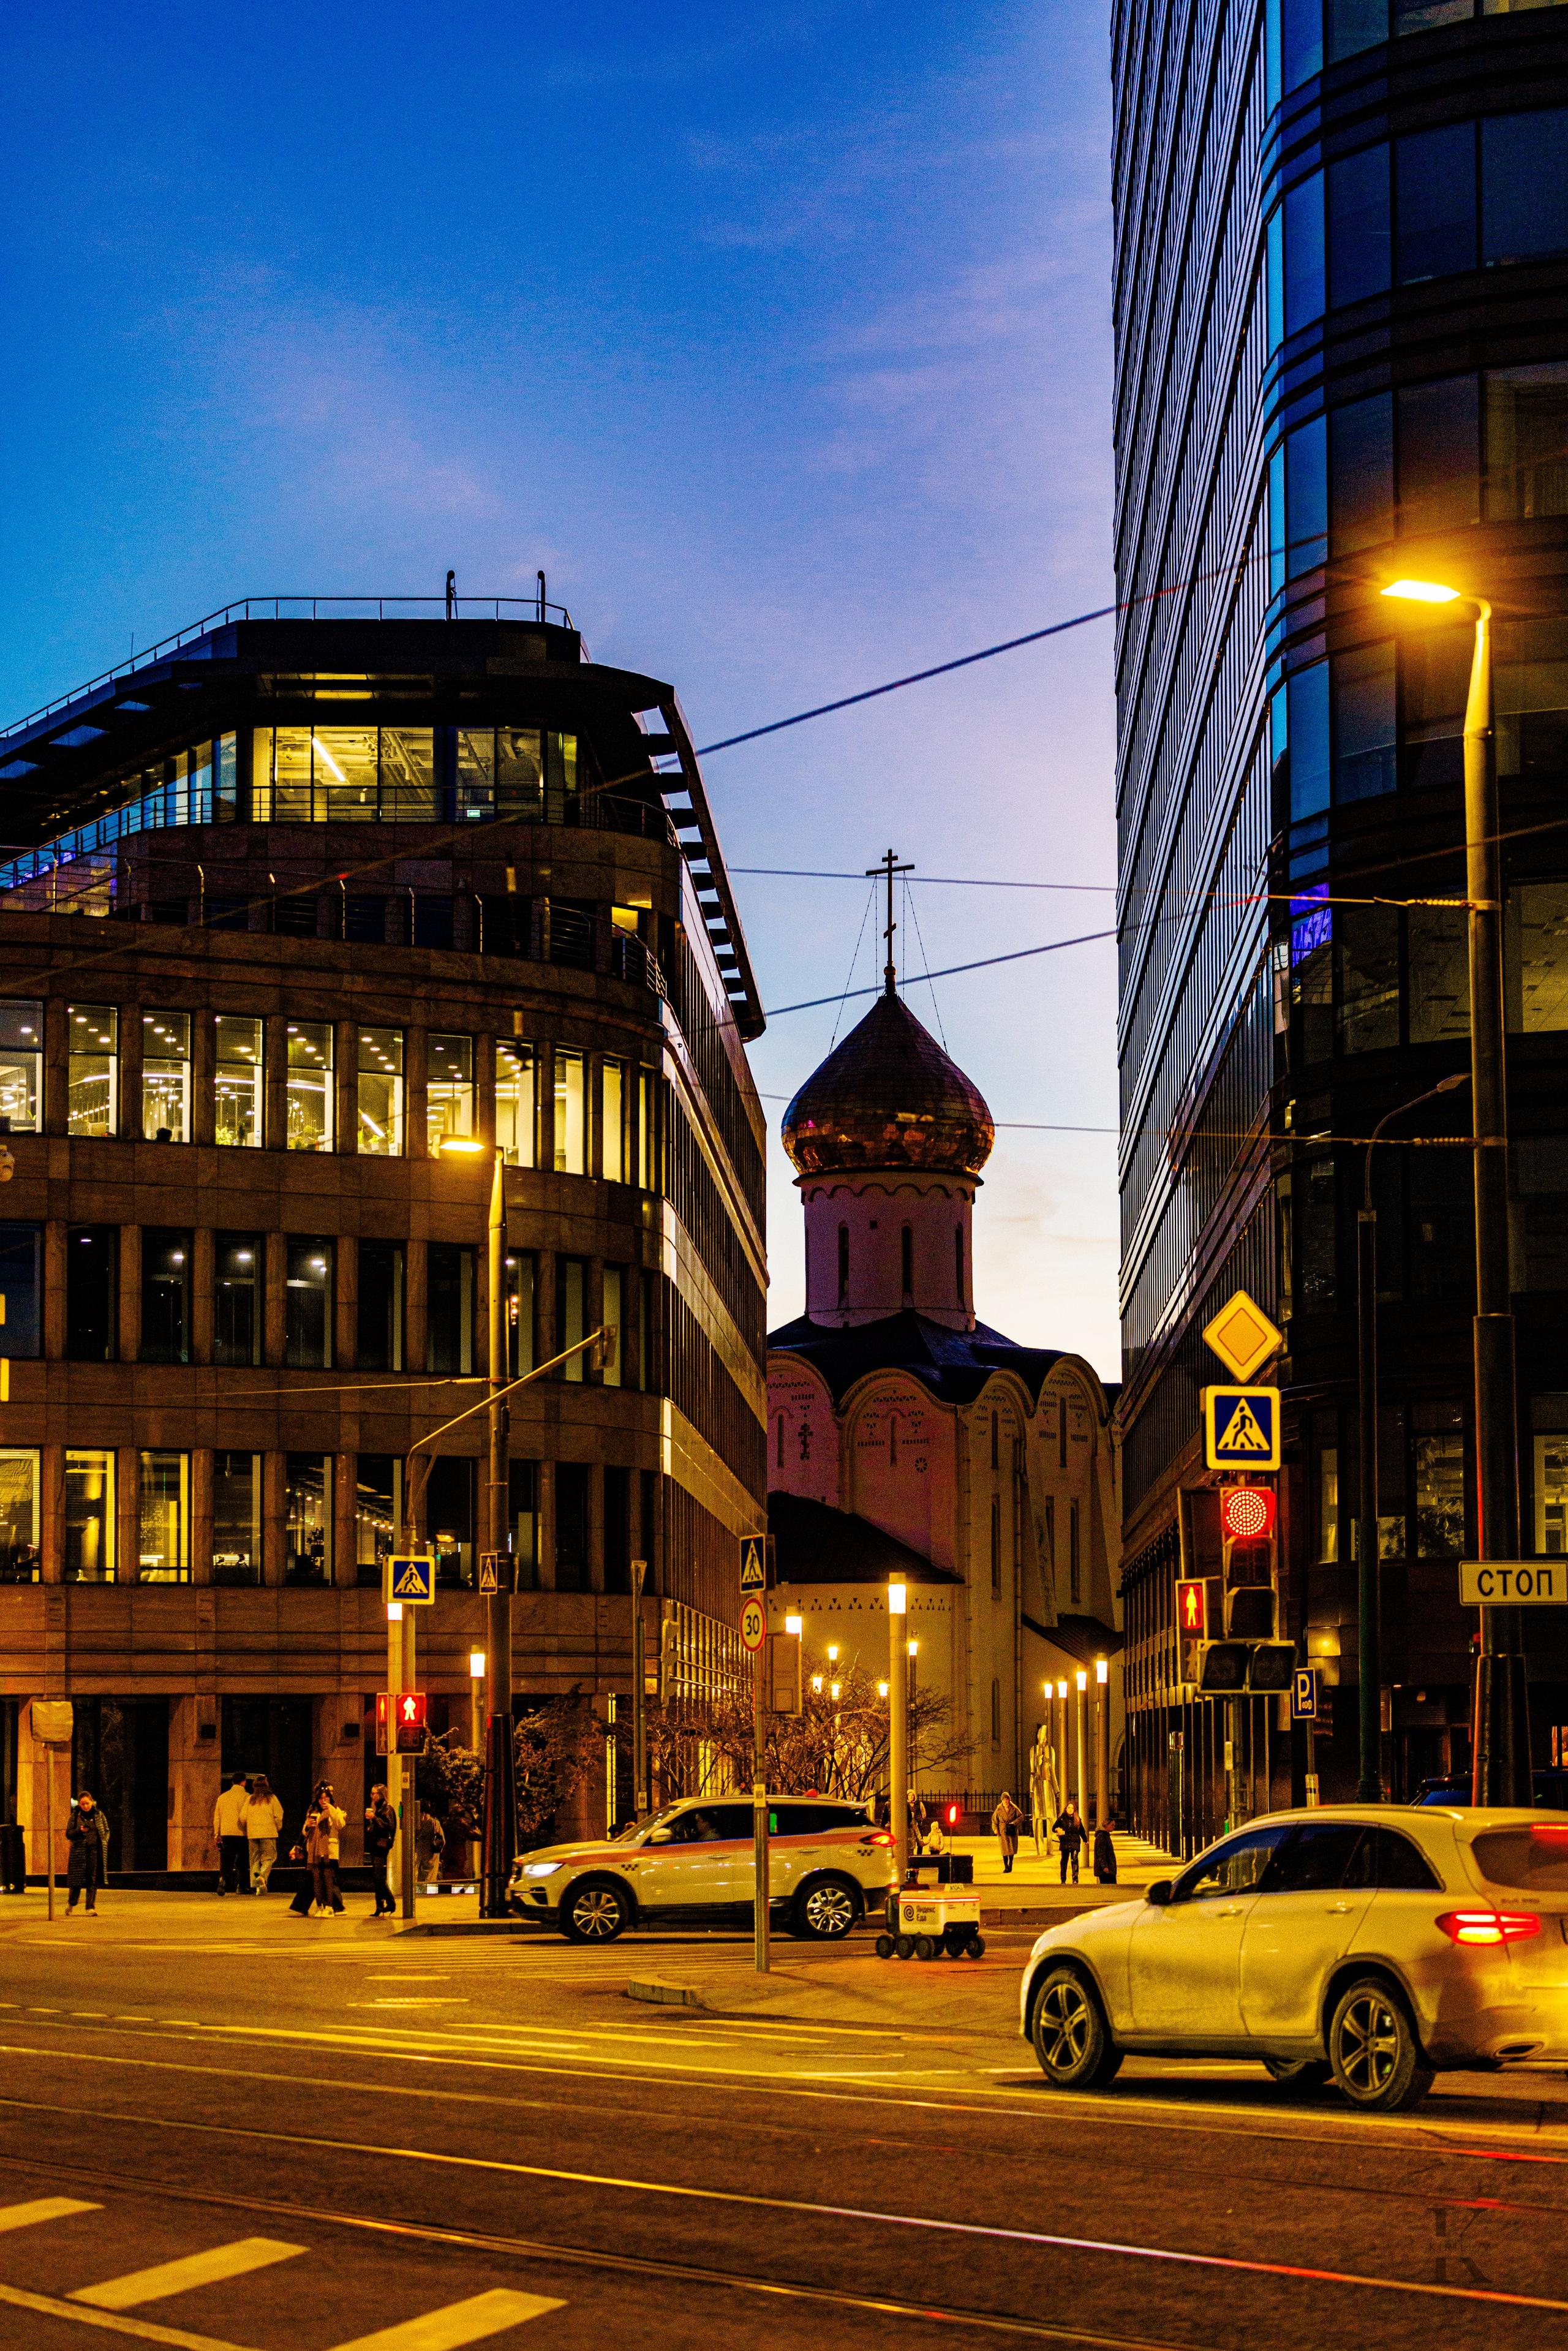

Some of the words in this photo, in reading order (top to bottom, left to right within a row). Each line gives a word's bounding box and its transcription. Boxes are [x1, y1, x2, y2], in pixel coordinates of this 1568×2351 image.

[1477, 1569, 1553, 1596] СТОП
[745, 1614, 760, 1636] 30
[1297, 1674, 1310, 1711] P
[916, 1905, 935, 1914] Яндекс
